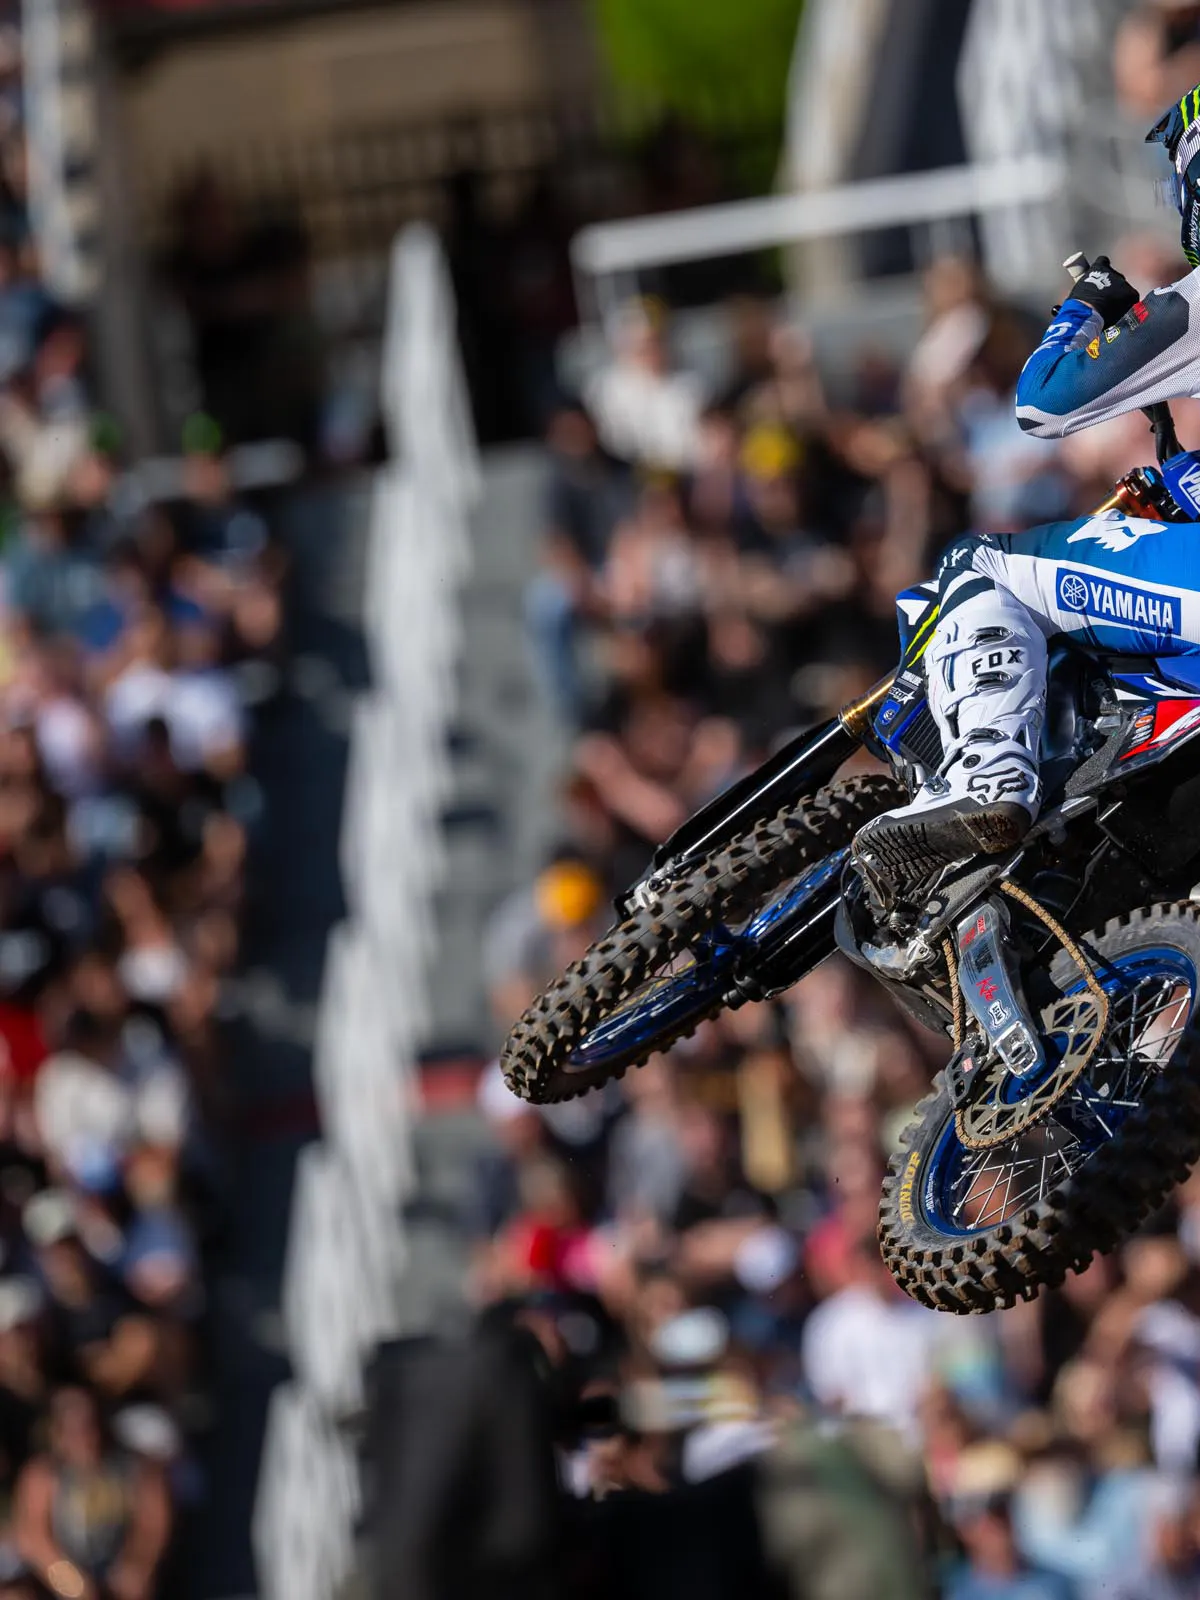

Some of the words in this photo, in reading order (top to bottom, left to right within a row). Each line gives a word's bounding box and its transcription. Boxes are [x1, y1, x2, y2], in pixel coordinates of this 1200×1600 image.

[1089, 581, 1174, 629] YAMAHA
[972, 649, 1024, 675] FOX
[900, 1151, 922, 1225] DUNLOP
